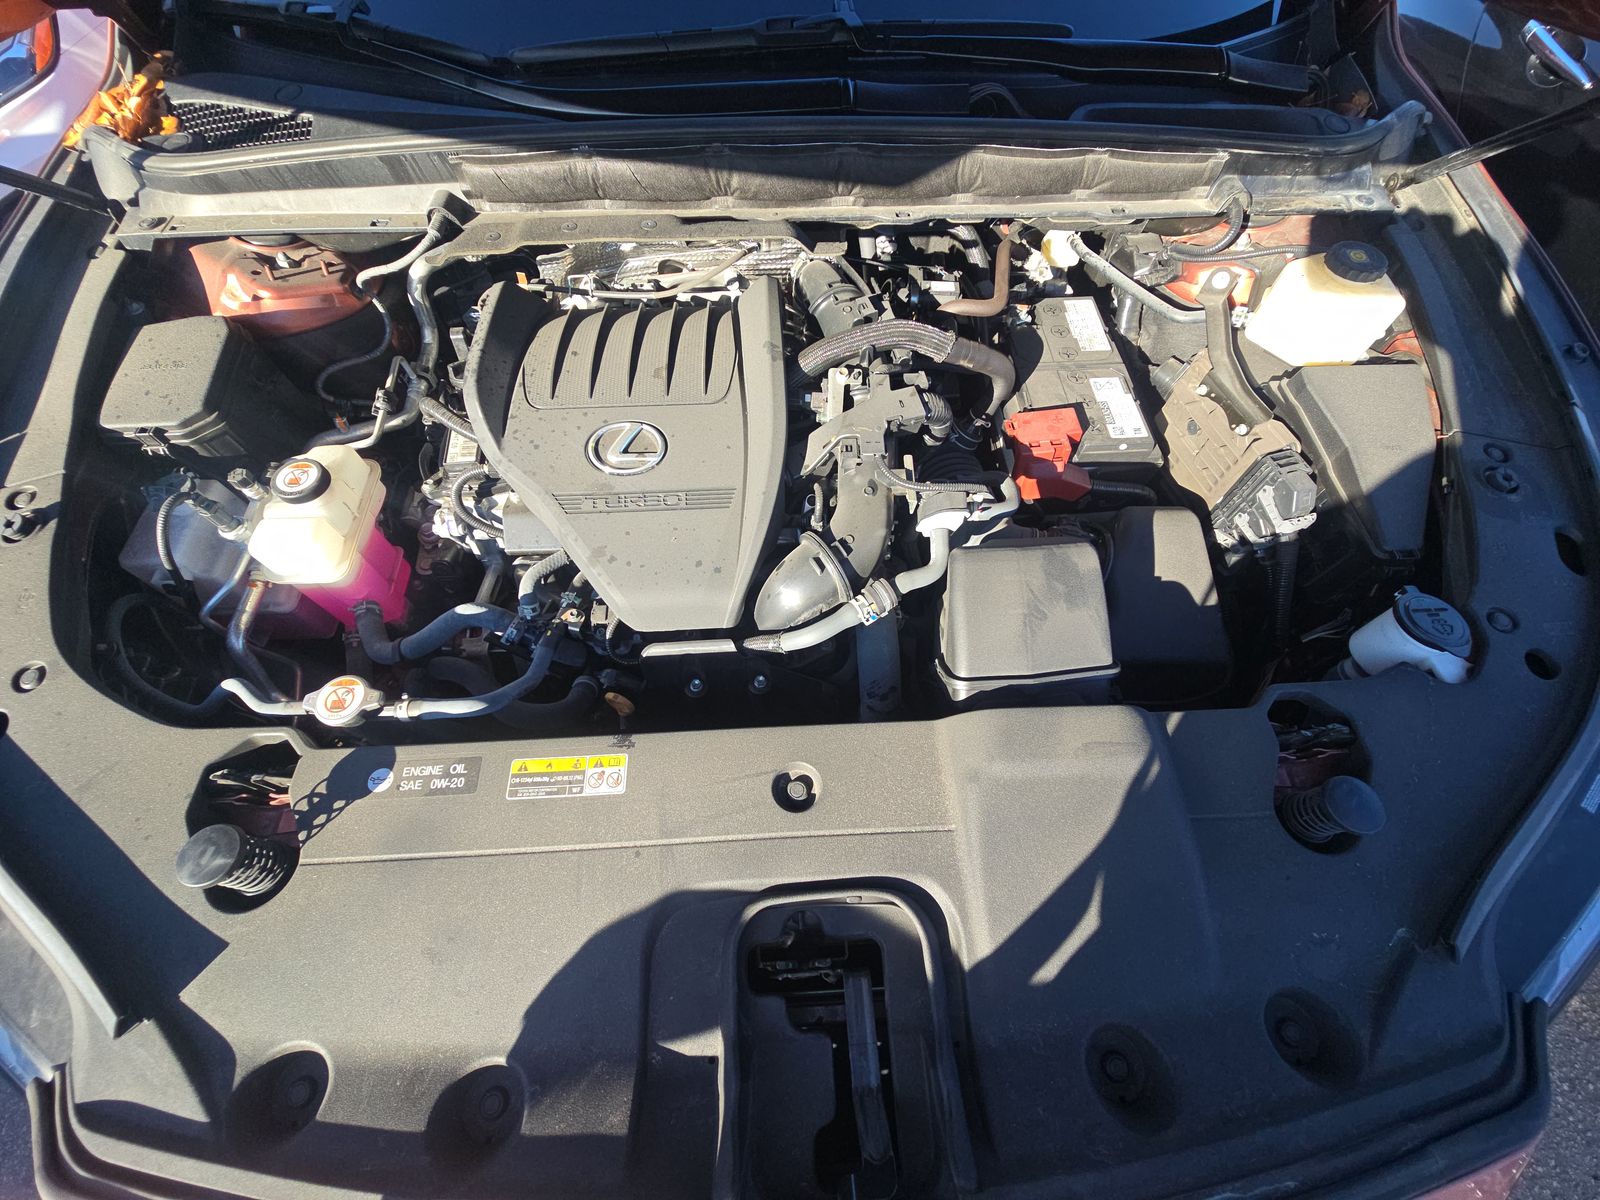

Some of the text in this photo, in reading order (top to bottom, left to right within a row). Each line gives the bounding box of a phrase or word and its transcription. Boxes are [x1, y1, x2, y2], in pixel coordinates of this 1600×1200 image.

[584, 493, 684, 509] TURBO
[402, 763, 468, 777] ENGINE OIL
[399, 777, 465, 791] SAE 0W-20
